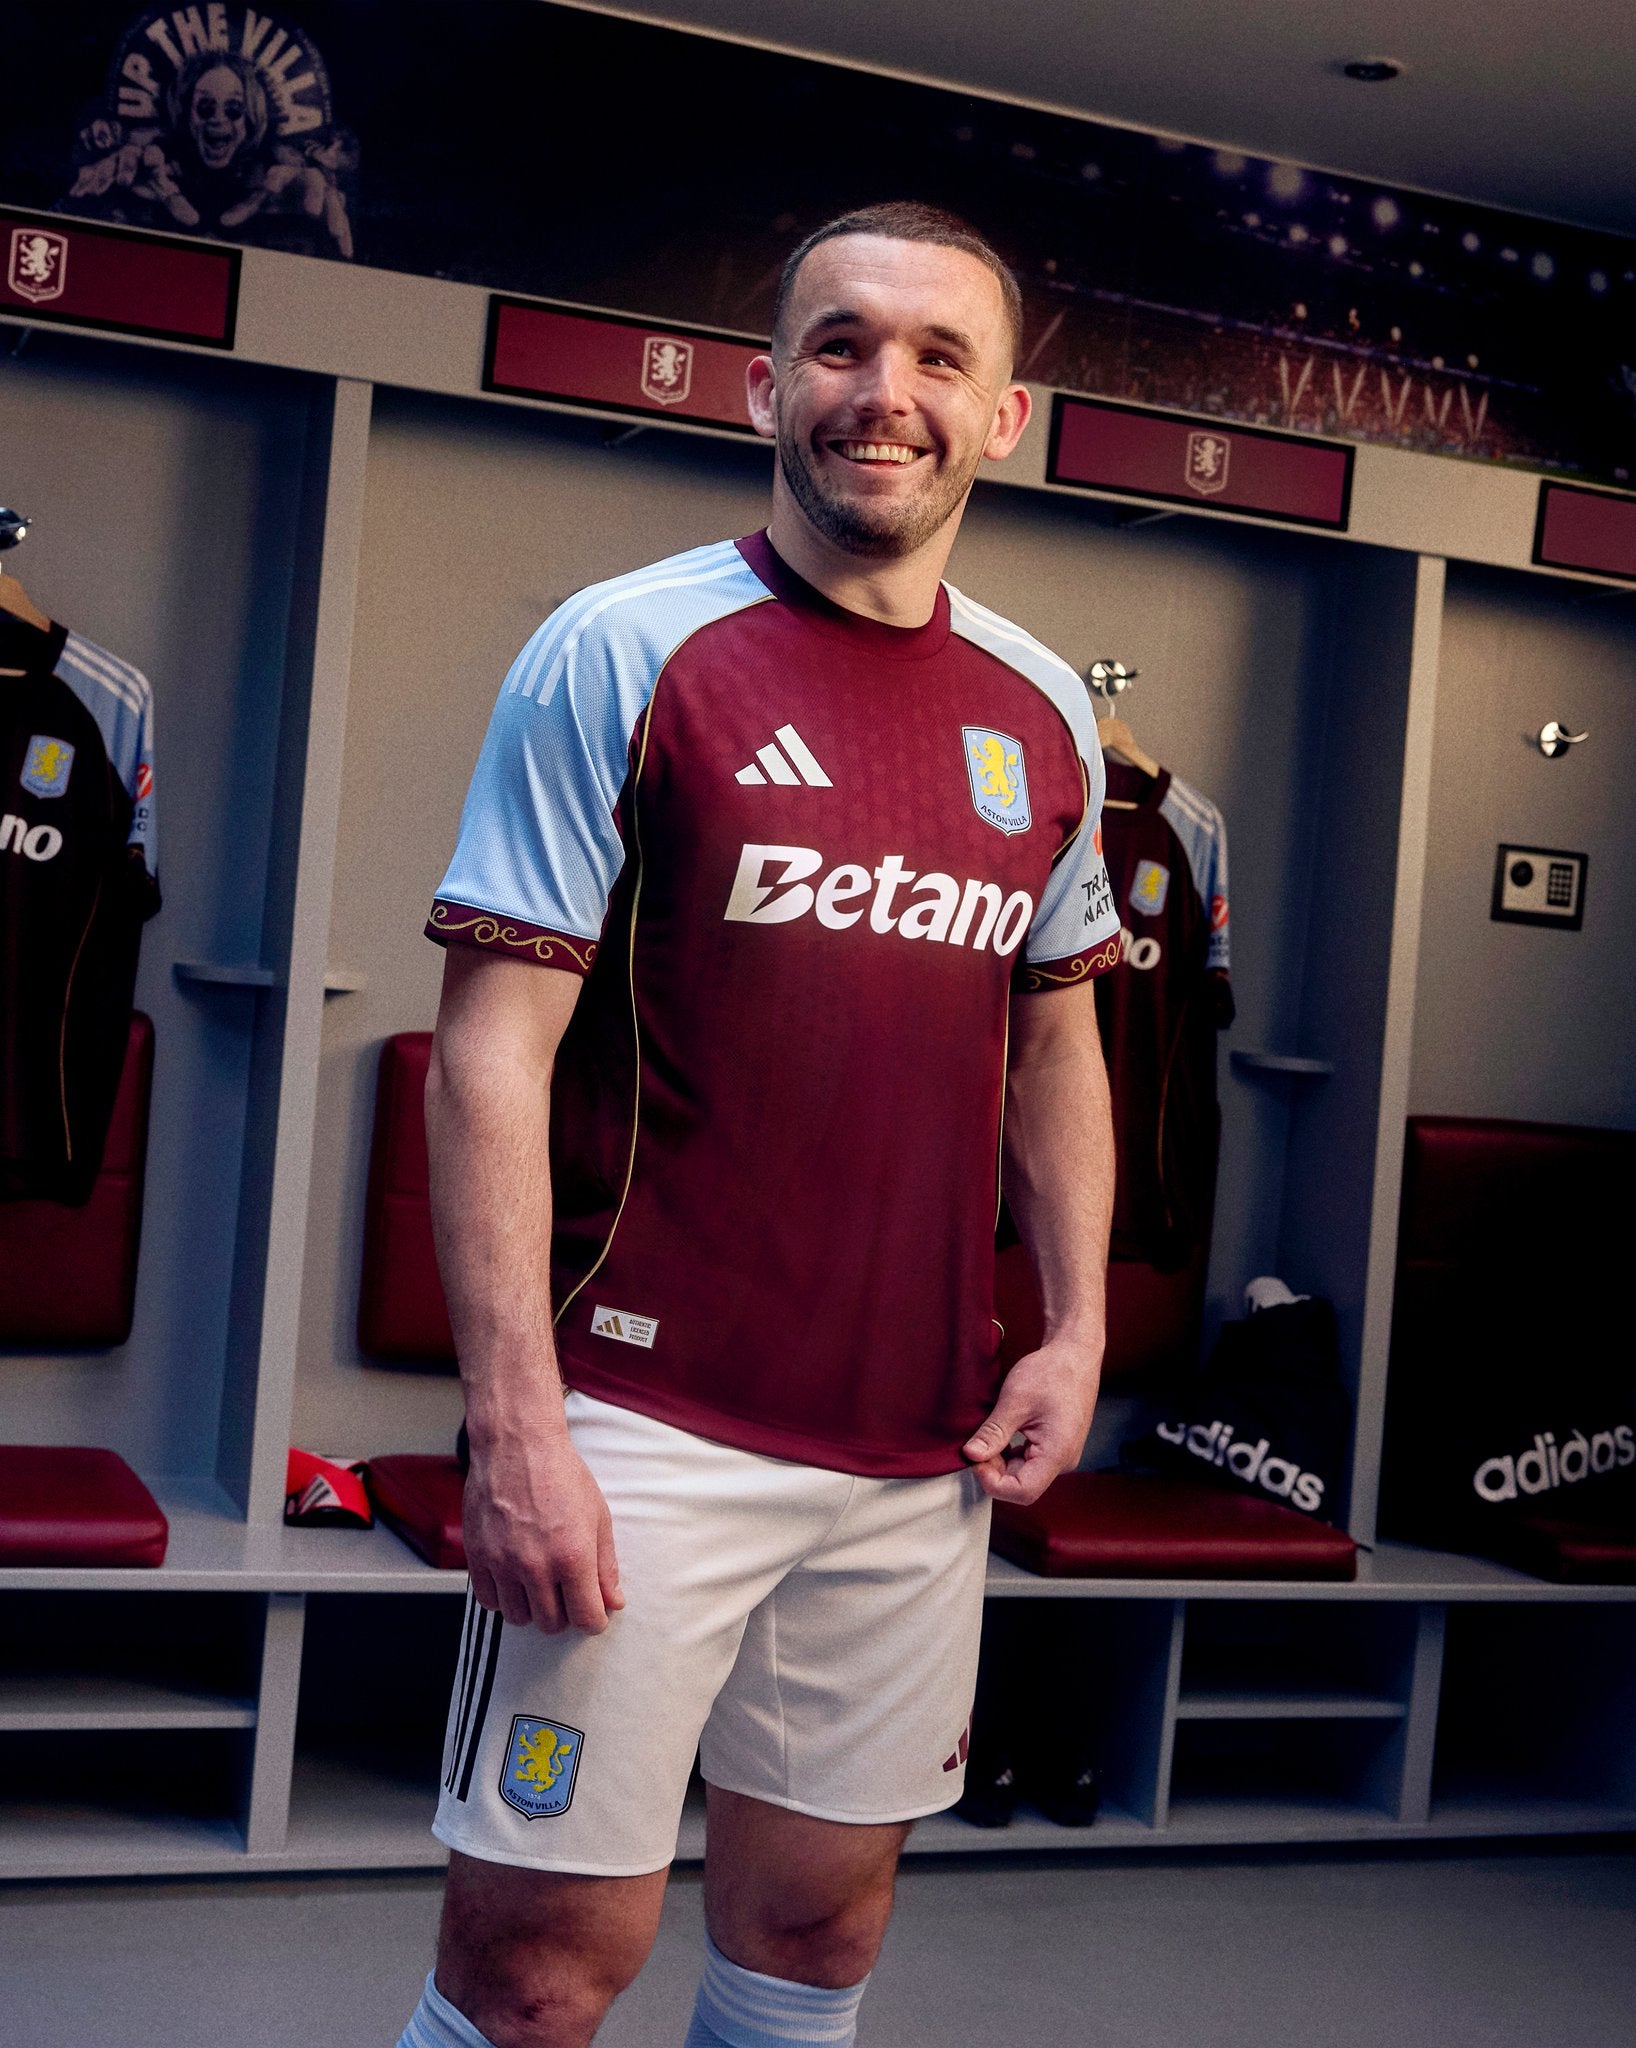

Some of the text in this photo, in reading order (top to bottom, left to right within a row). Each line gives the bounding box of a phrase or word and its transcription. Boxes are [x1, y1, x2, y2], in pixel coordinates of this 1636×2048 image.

[117, 53, 159, 117] UP
[146, 3, 229, 70] THE
[240, 8, 322, 136] VILLA
[980, 805, 1008, 825] ASTON
[1008, 815, 1028, 827] VILLA
[724, 843, 1034, 957] Betano
[1473, 1424, 1636, 1503] adidas
[506, 1788, 561, 1810] ASTON VILLA
